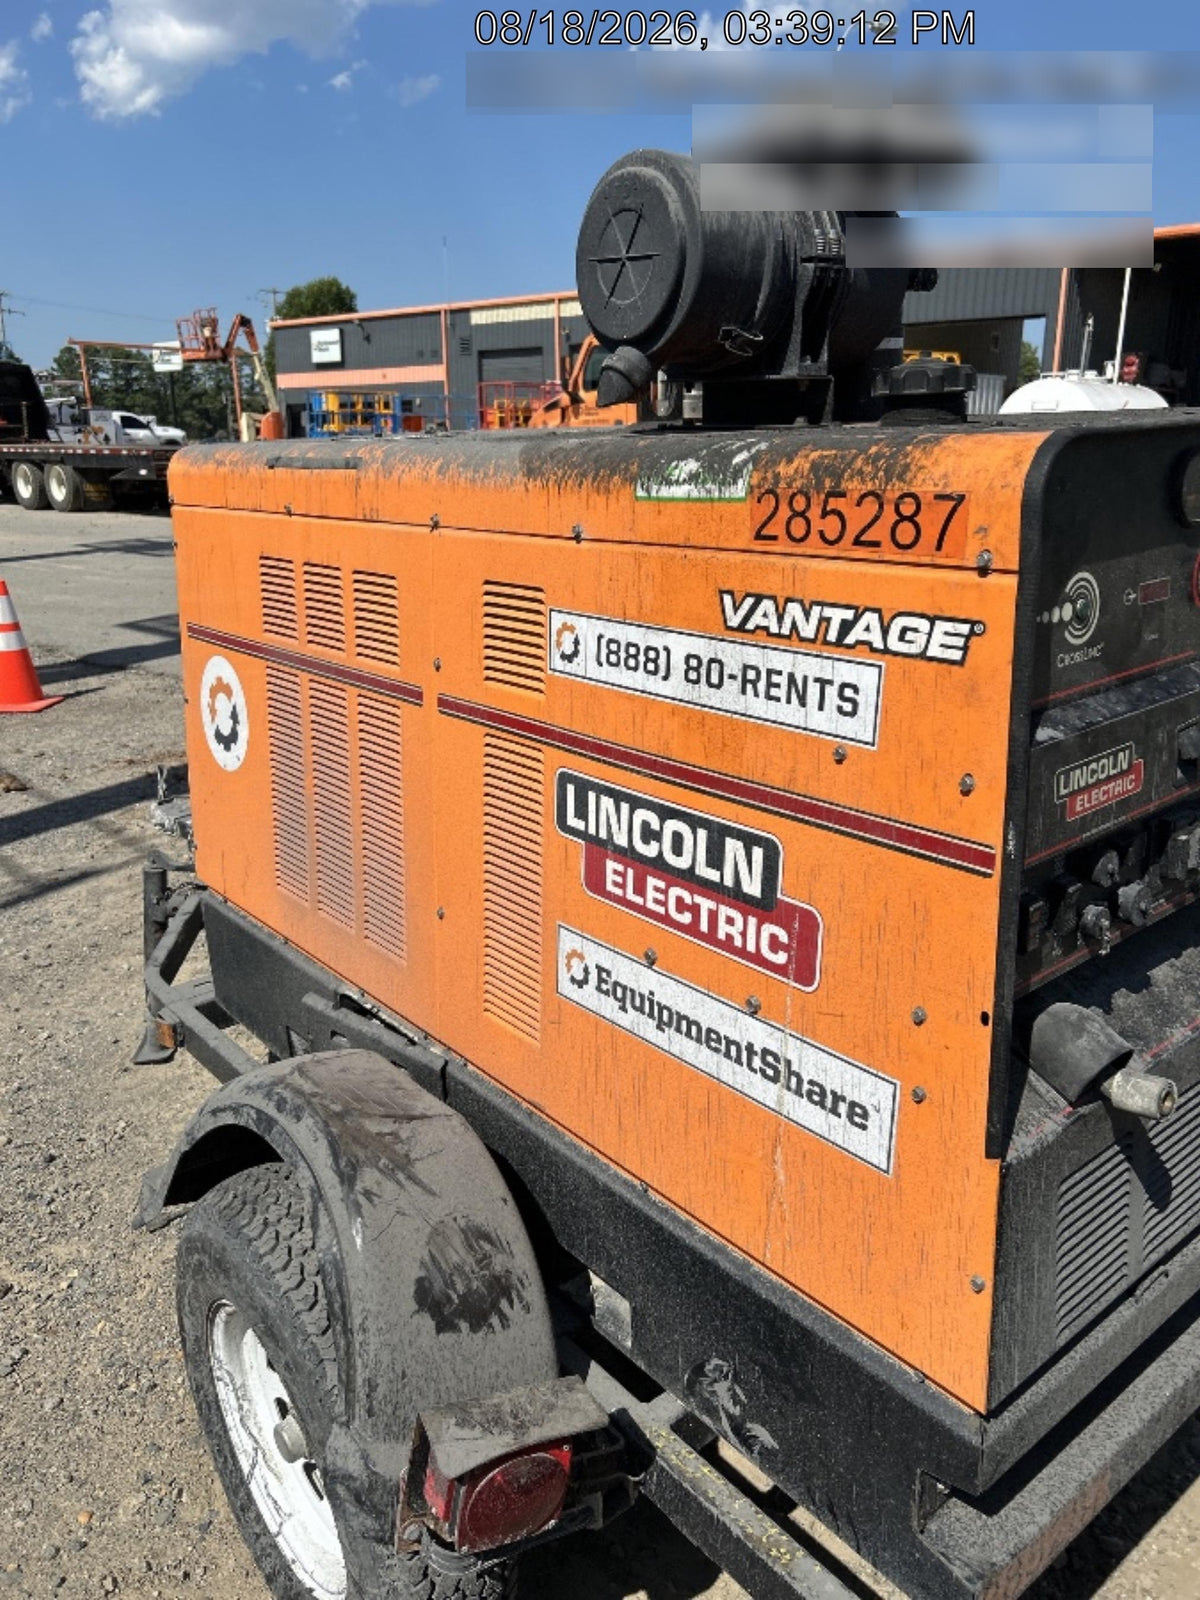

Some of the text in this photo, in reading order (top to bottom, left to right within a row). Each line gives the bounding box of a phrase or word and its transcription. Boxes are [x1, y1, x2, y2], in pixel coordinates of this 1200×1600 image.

[753, 488, 966, 552] 285287
[595, 633, 860, 719] (888) 80-RENTS
[1059, 749, 1130, 796] LINCOLN
[1075, 774, 1136, 812] ELECTRIC
[565, 782, 764, 899] LINCOLN
[604, 858, 789, 965] ELECTRIC
[594, 963, 871, 1132] EquipmentShare
